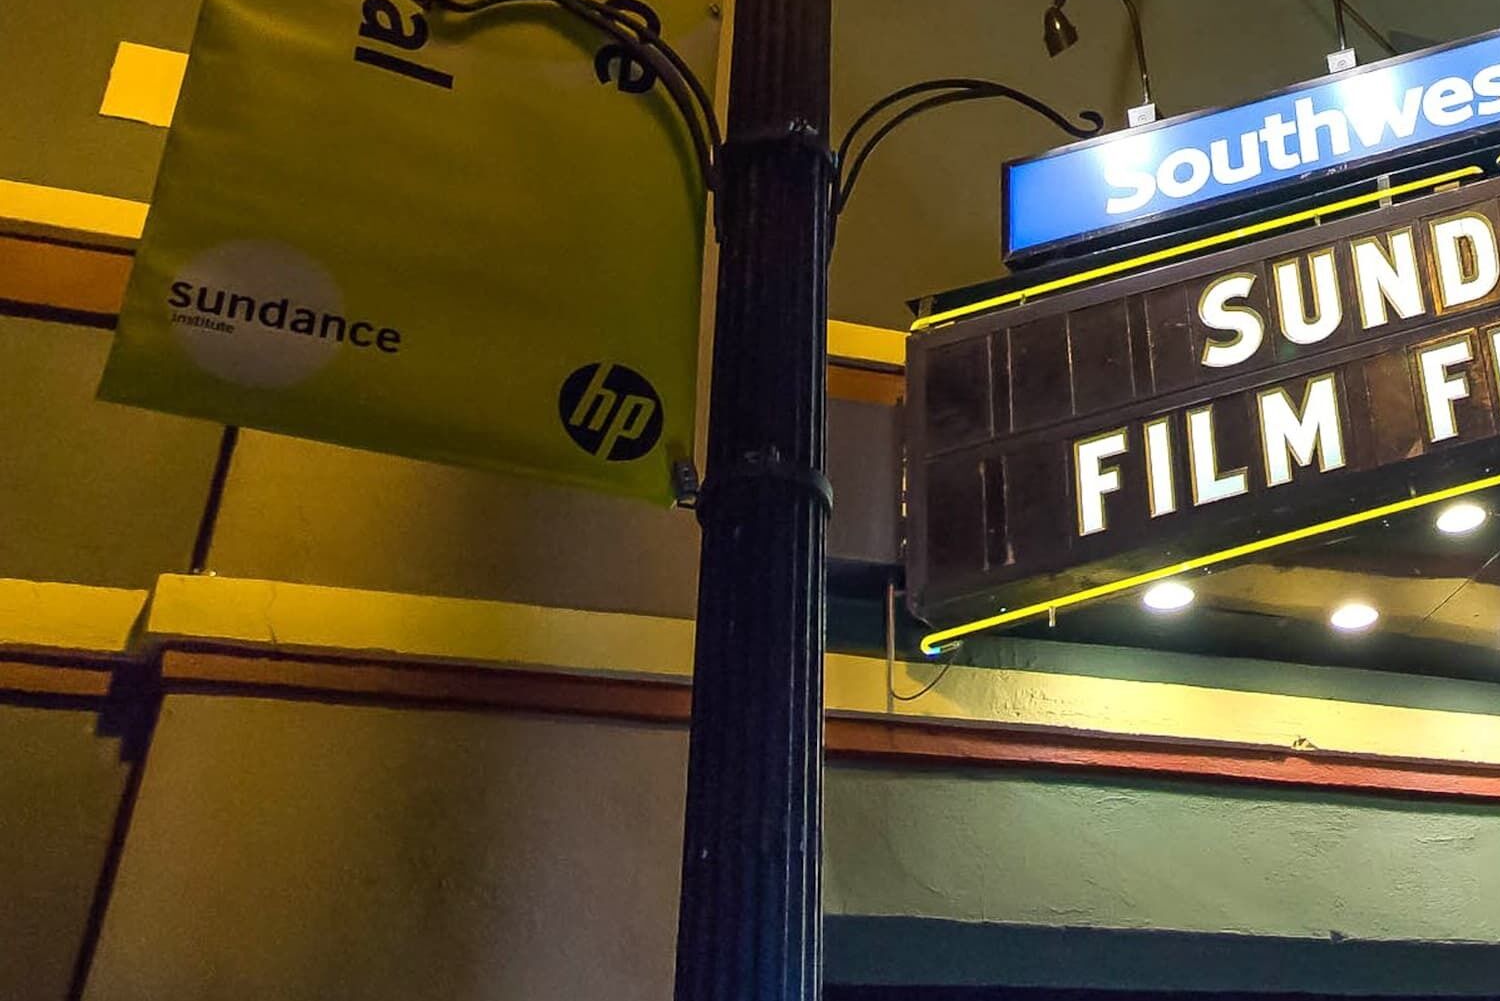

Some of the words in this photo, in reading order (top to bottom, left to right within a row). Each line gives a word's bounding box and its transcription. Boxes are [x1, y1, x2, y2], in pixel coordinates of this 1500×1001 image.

[168, 281, 401, 354] sundance
[171, 312, 236, 335] institute
[563, 362, 660, 461] hp
[1073, 370, 1346, 537] FILM
